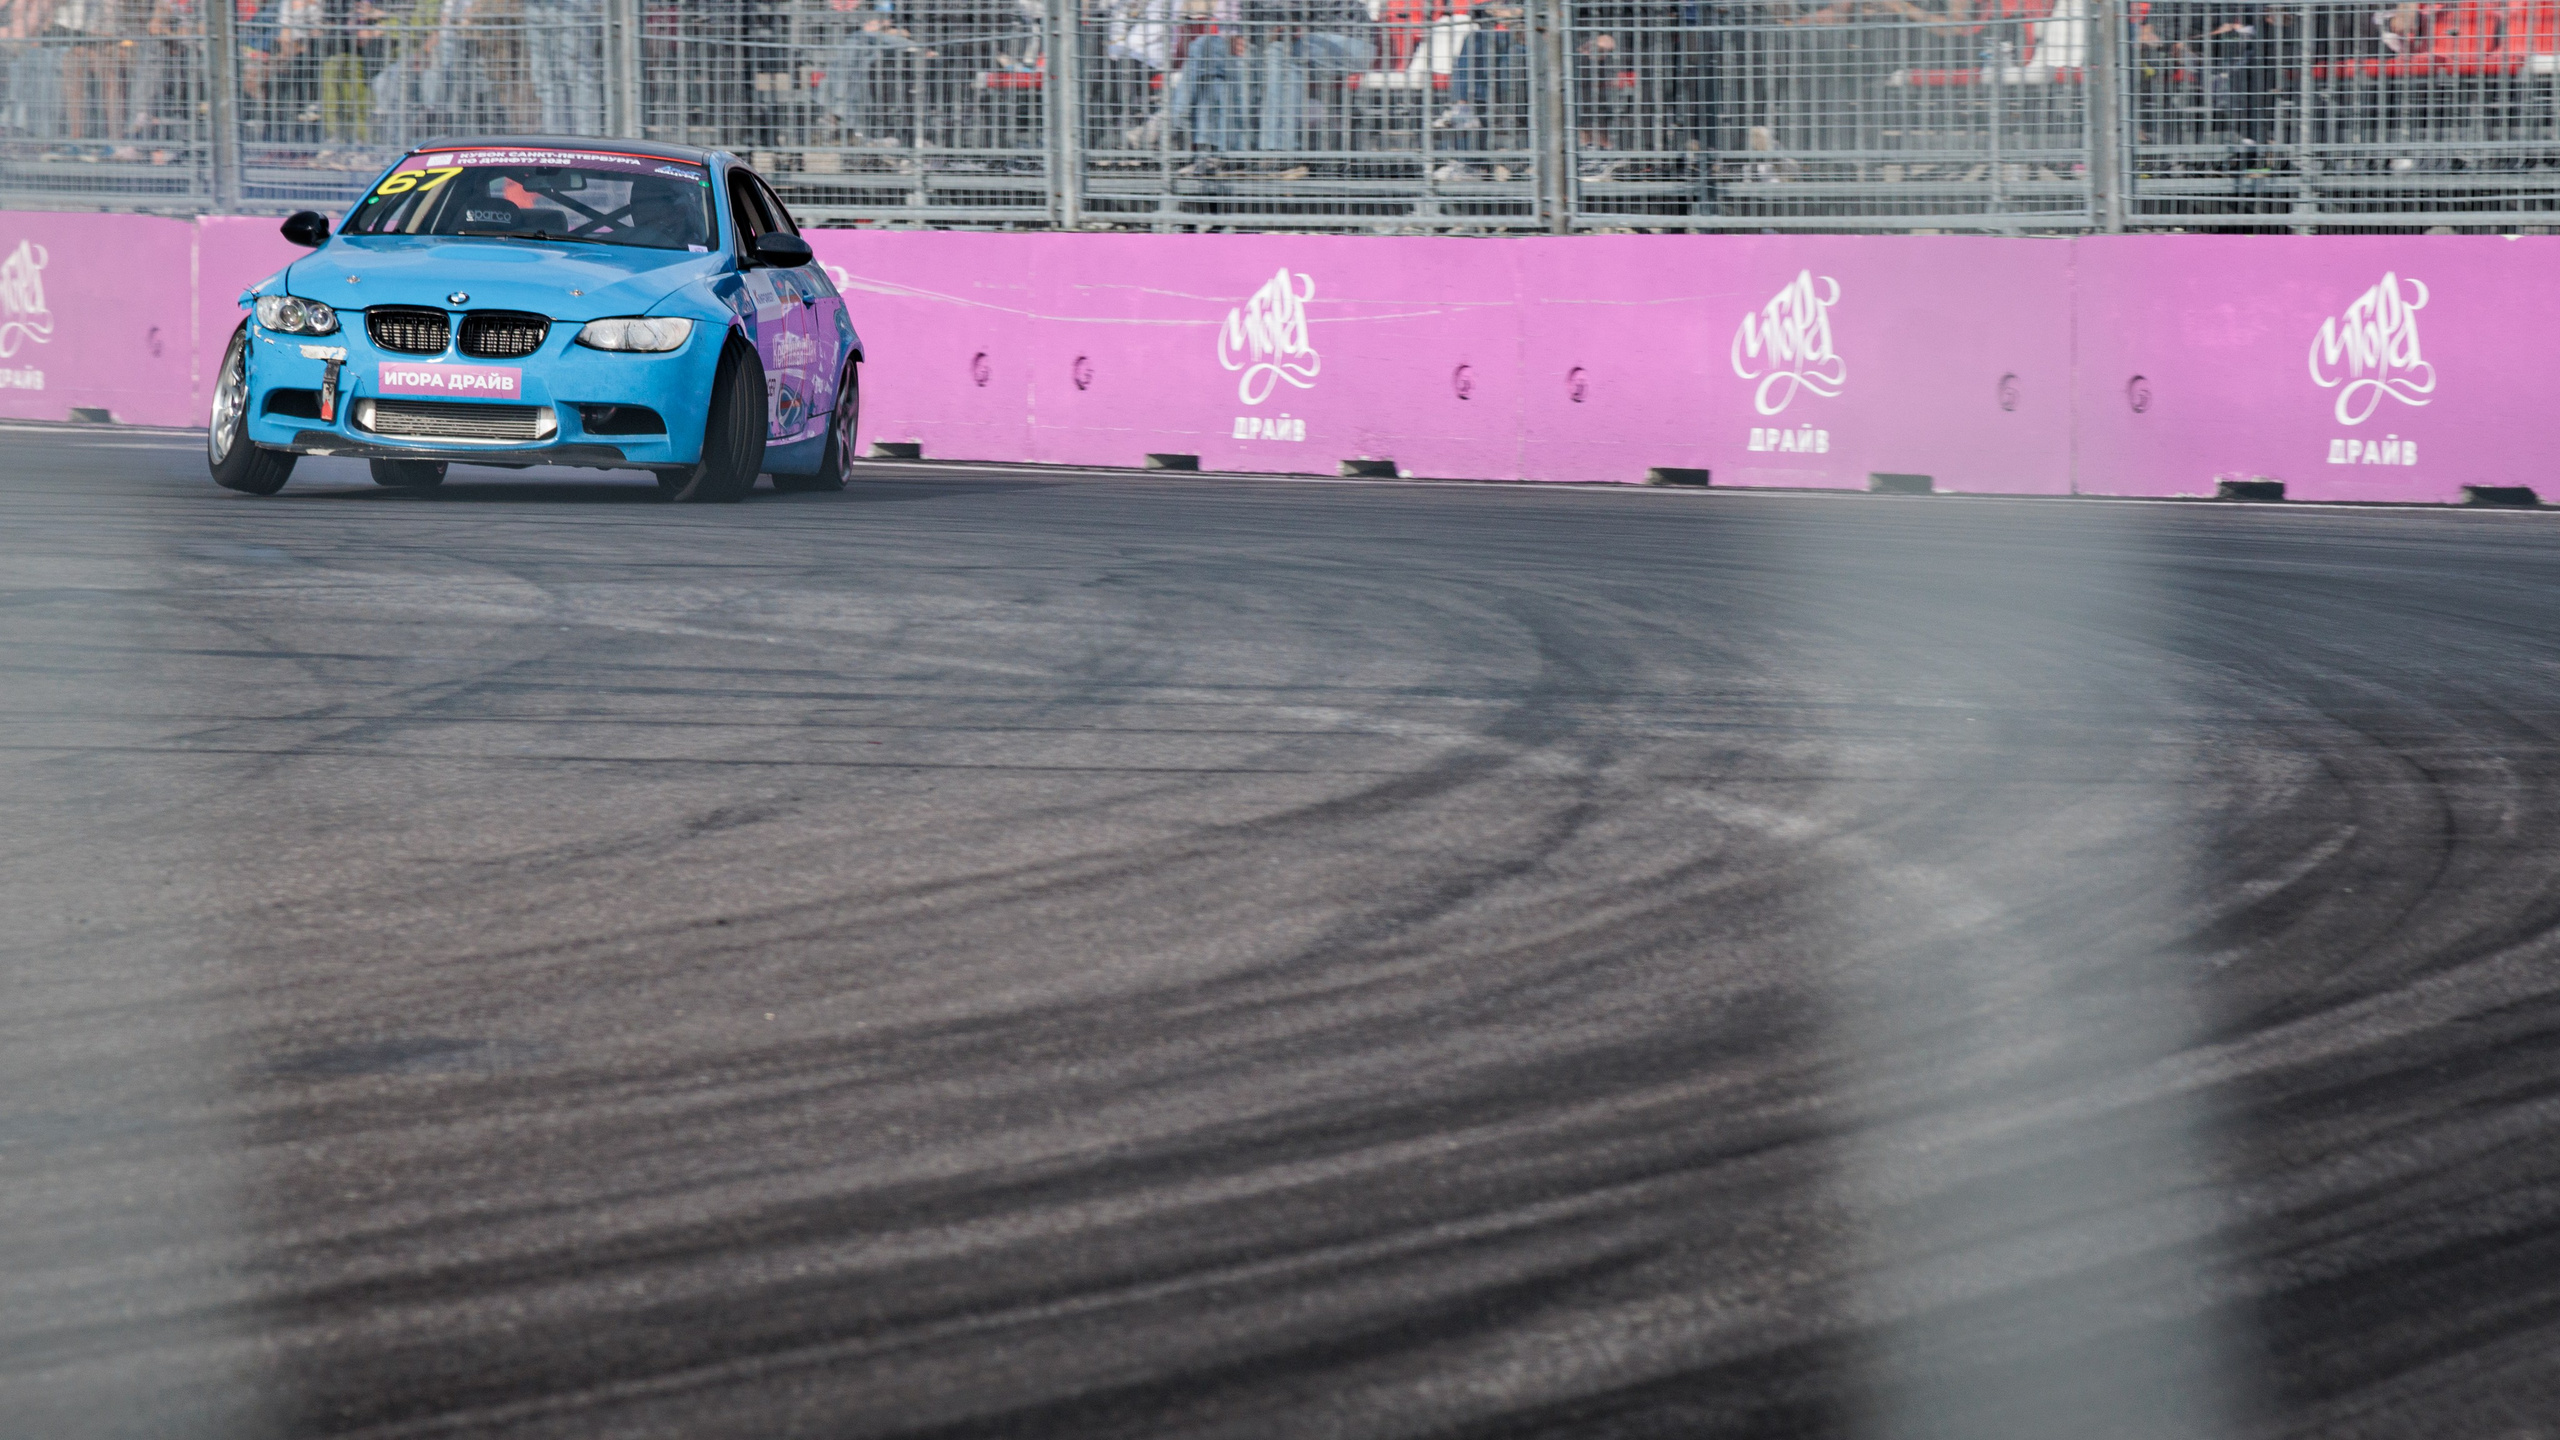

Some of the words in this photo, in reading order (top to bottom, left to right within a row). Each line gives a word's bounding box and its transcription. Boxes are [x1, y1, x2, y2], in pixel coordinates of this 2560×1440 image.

[459, 151, 506, 159] КУБОК
[508, 151, 641, 166] САНКТ-ПЕТЕРБУРГА
[479, 156, 537, 164] ДРИФТУ
[377, 166, 464, 195] 67
[0, 365, 45, 390] РАЙВ
[384, 371, 444, 388] ИГОРА
[448, 372, 514, 391] ДРАЙВ
[1231, 413, 1307, 441] ДРАЙВ
[1747, 423, 1830, 454] ДРАЙВ
[2326, 434, 2418, 465] ДРАЙВ
